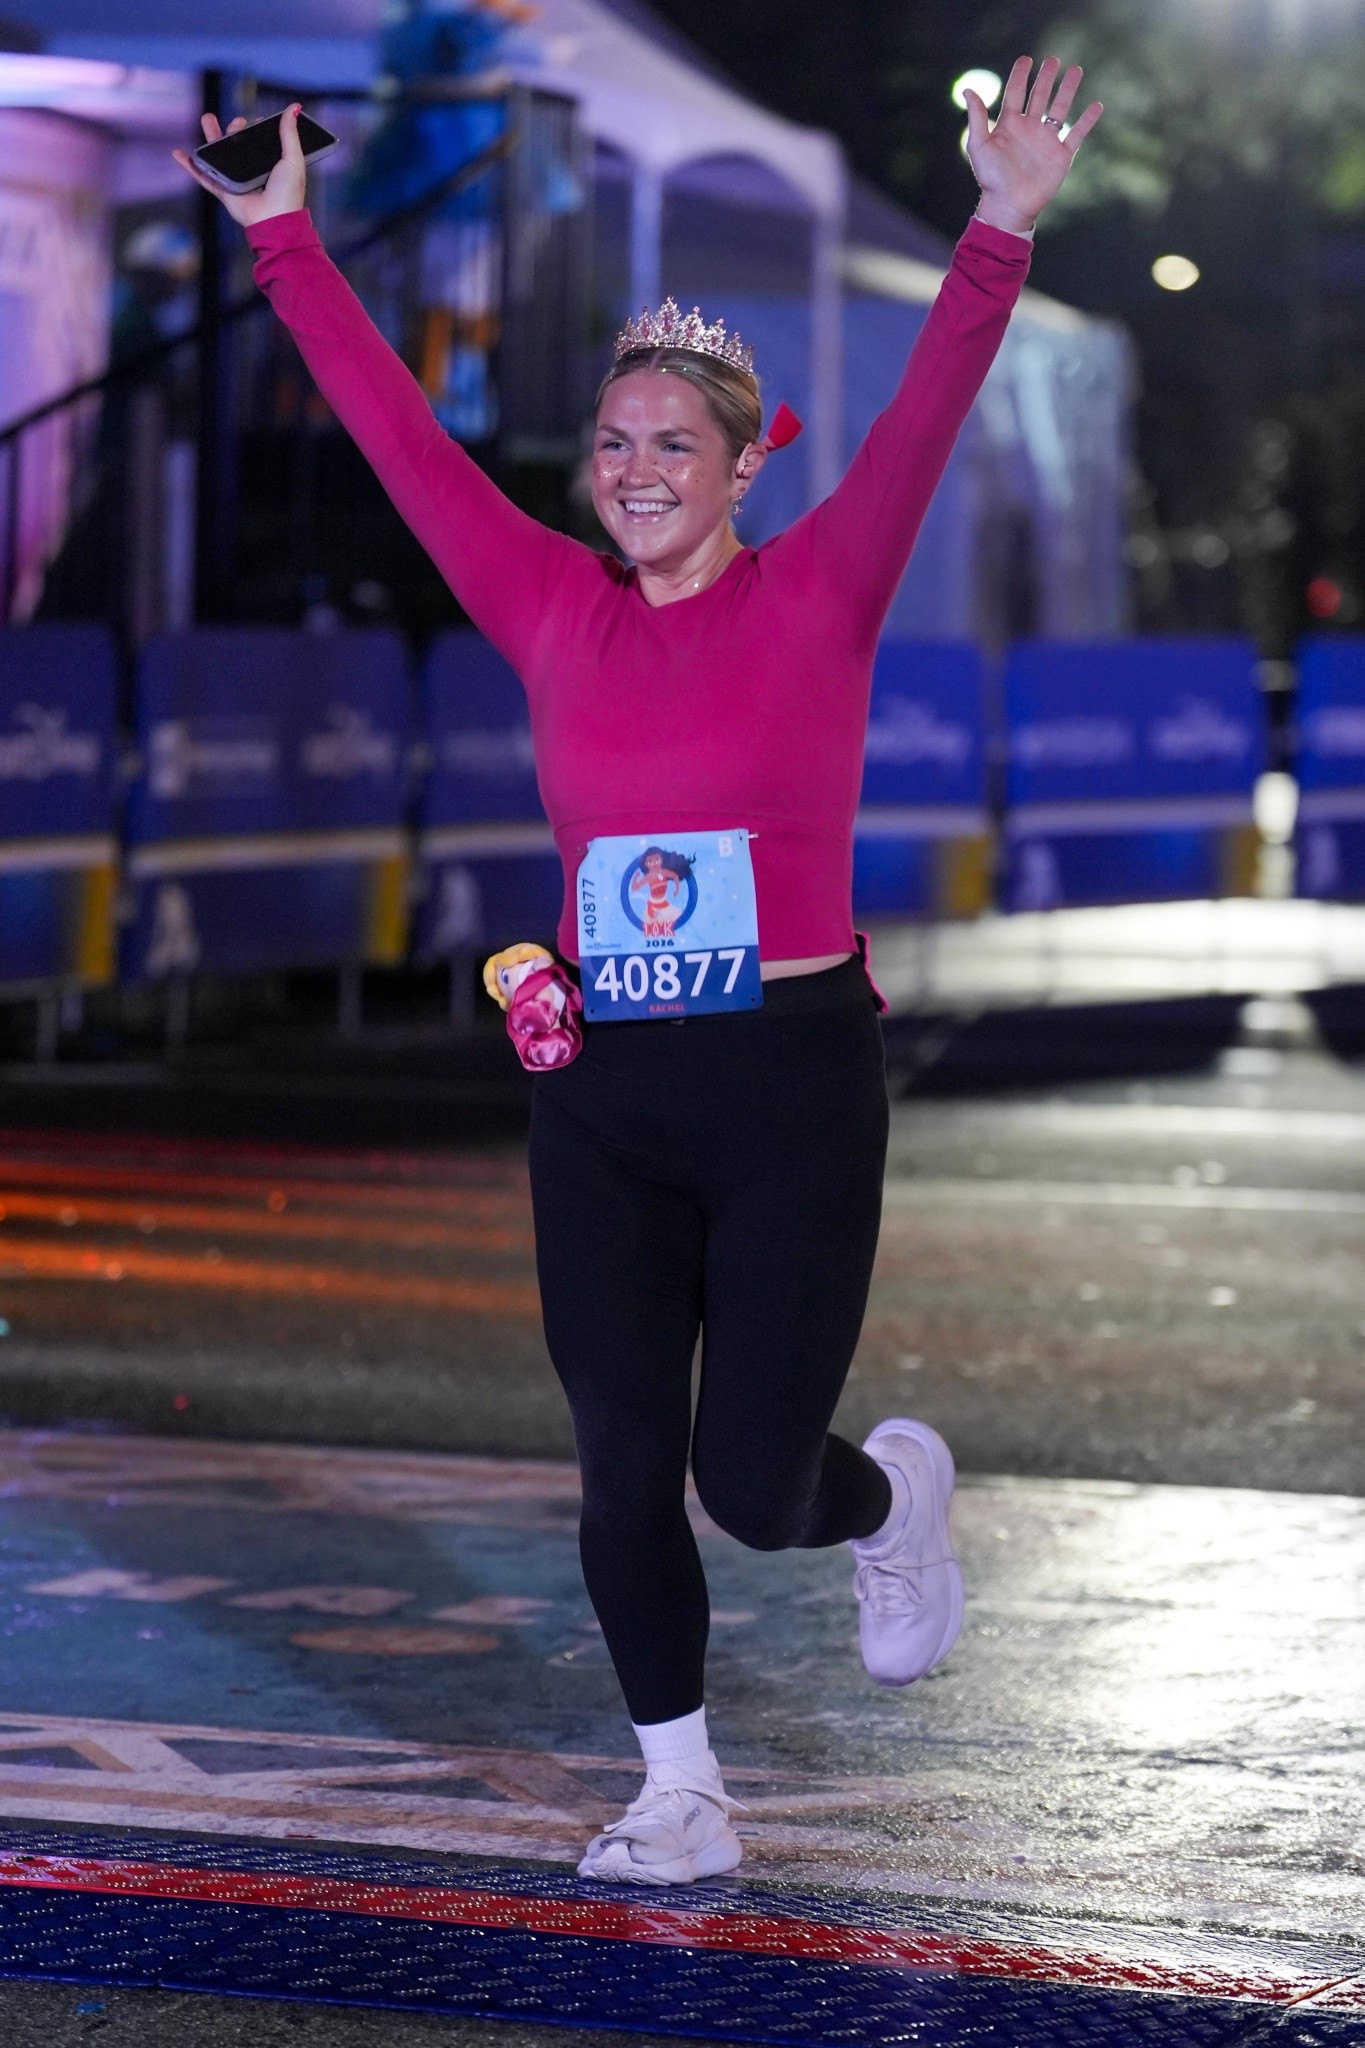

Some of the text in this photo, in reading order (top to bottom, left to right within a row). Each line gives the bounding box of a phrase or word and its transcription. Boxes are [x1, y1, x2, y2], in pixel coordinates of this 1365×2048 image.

[719, 836, 733, 857] B
[582, 878, 597, 938] 40877
[643, 921, 676, 938] 10K
[594, 948, 746, 1002] 40877
